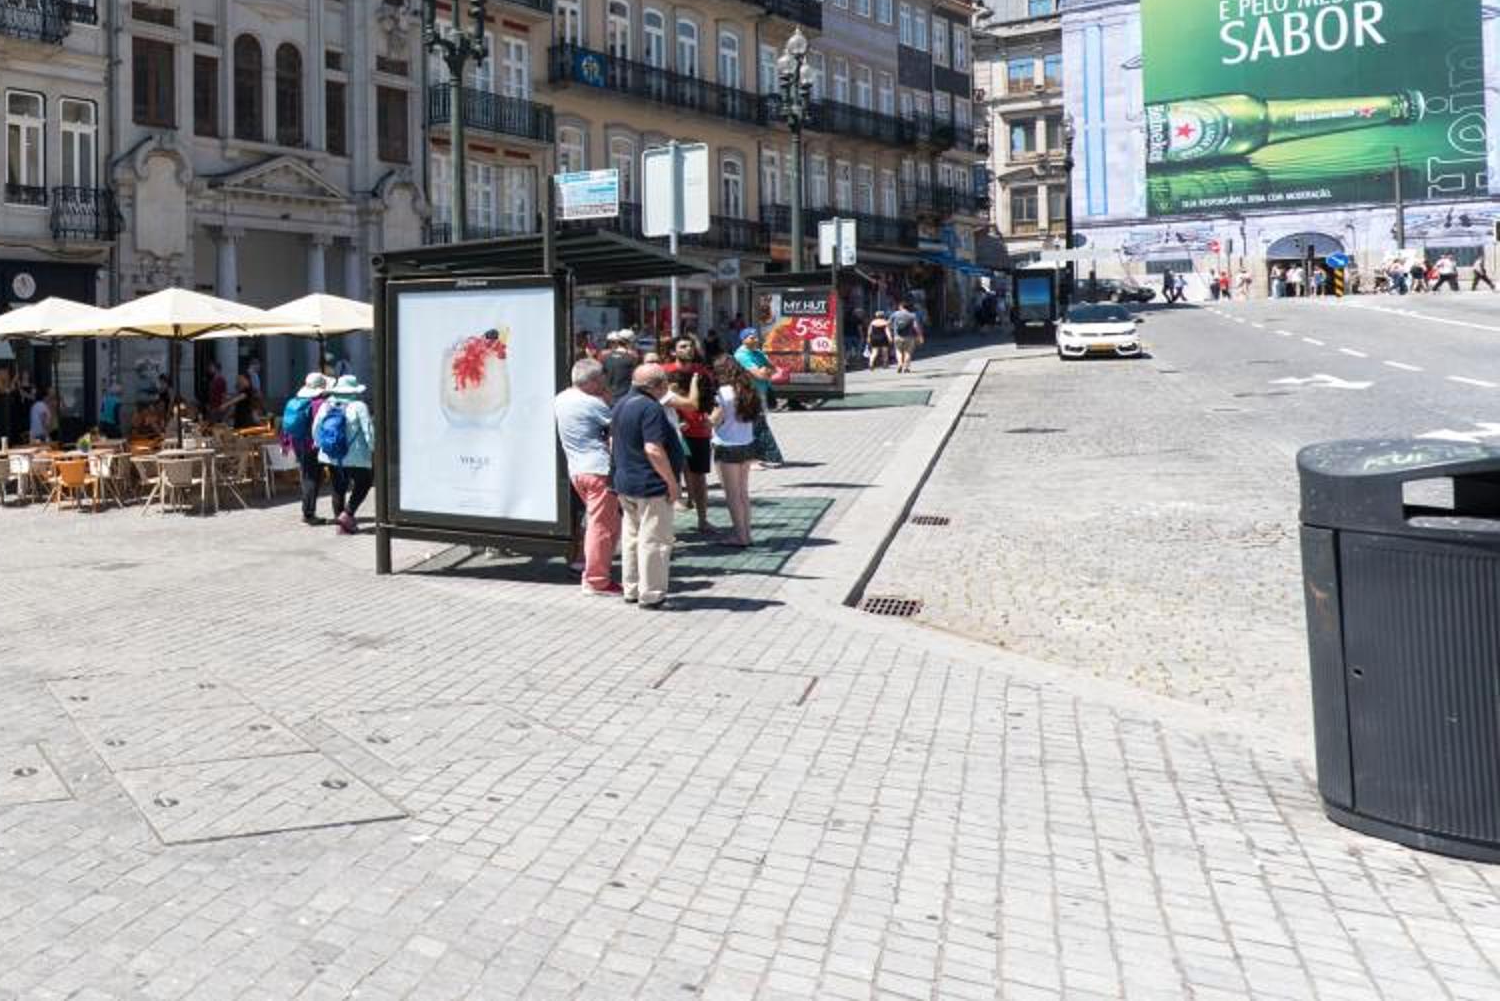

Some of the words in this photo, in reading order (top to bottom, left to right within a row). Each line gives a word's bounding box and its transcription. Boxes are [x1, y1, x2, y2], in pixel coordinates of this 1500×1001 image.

[1219, 0, 1230, 21] E
[1219, 0, 1387, 65] SABOR
[783, 299, 800, 311] MY
[803, 299, 827, 311] HUT
